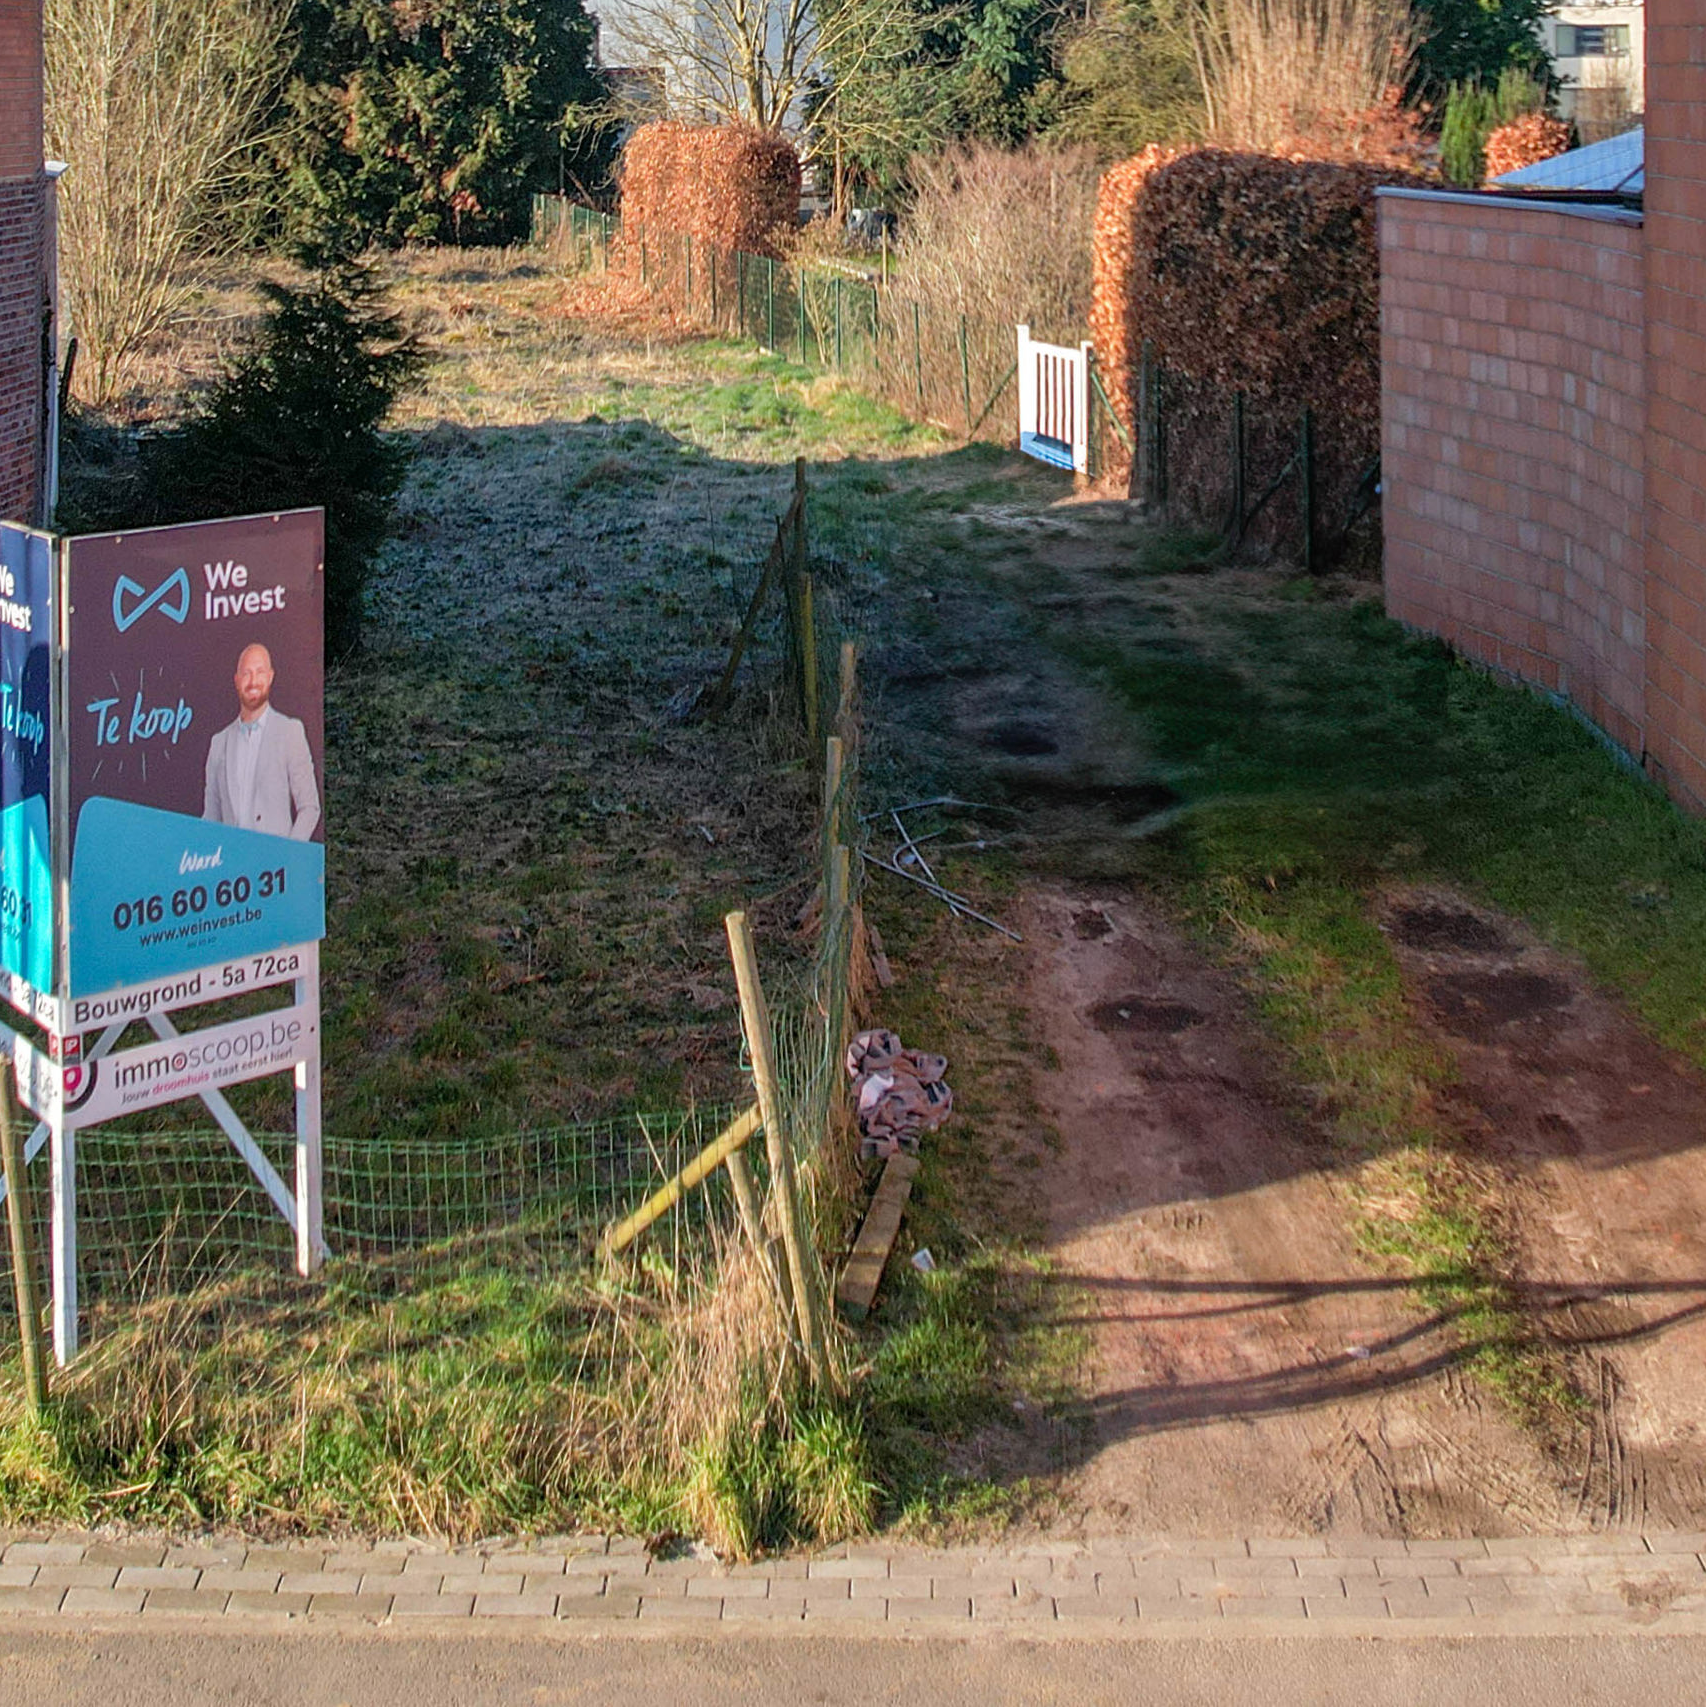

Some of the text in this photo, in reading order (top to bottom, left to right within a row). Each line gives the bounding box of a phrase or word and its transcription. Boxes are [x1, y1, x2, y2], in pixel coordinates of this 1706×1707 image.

[204, 560, 248, 591] We
[205, 585, 286, 620] Invest
[86, 691, 192, 746] Te koop
[178, 846, 223, 875] Ward
[113, 867, 285, 930] 016 60 60 31
[139, 907, 262, 947] www.weinvest.be
[75, 973, 202, 1024] Bouwgrond
[222, 965, 246, 987] 5a
[253, 954, 299, 980] 72ca
[114, 1019, 301, 1089] immoscoop.be
[152, 1072, 210, 1095] droomhuis
[213, 1063, 239, 1078] staat
[242, 1055, 268, 1071] eerst
